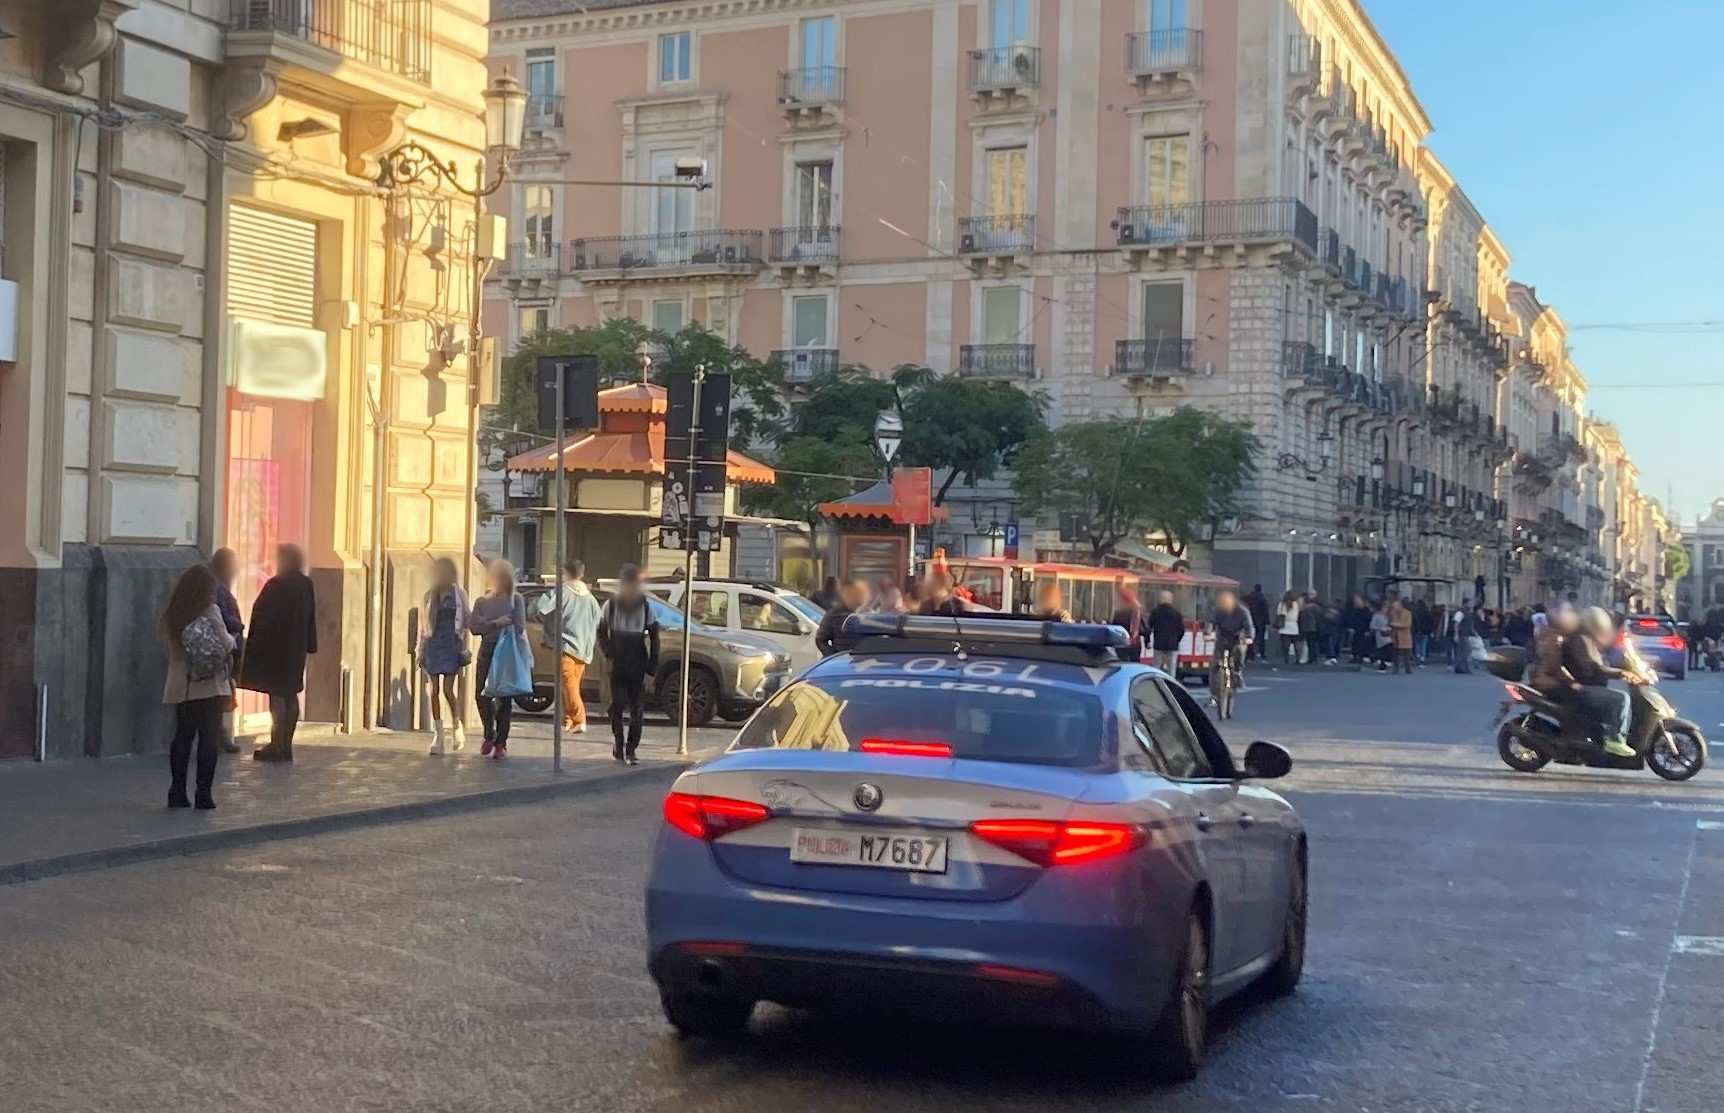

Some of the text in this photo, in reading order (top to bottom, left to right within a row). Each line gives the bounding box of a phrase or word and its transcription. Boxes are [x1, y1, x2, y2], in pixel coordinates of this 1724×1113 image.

[1007, 525, 1016, 545] P
[840, 679, 1037, 698] POLIZIA
[859, 834, 940, 868] M7687
